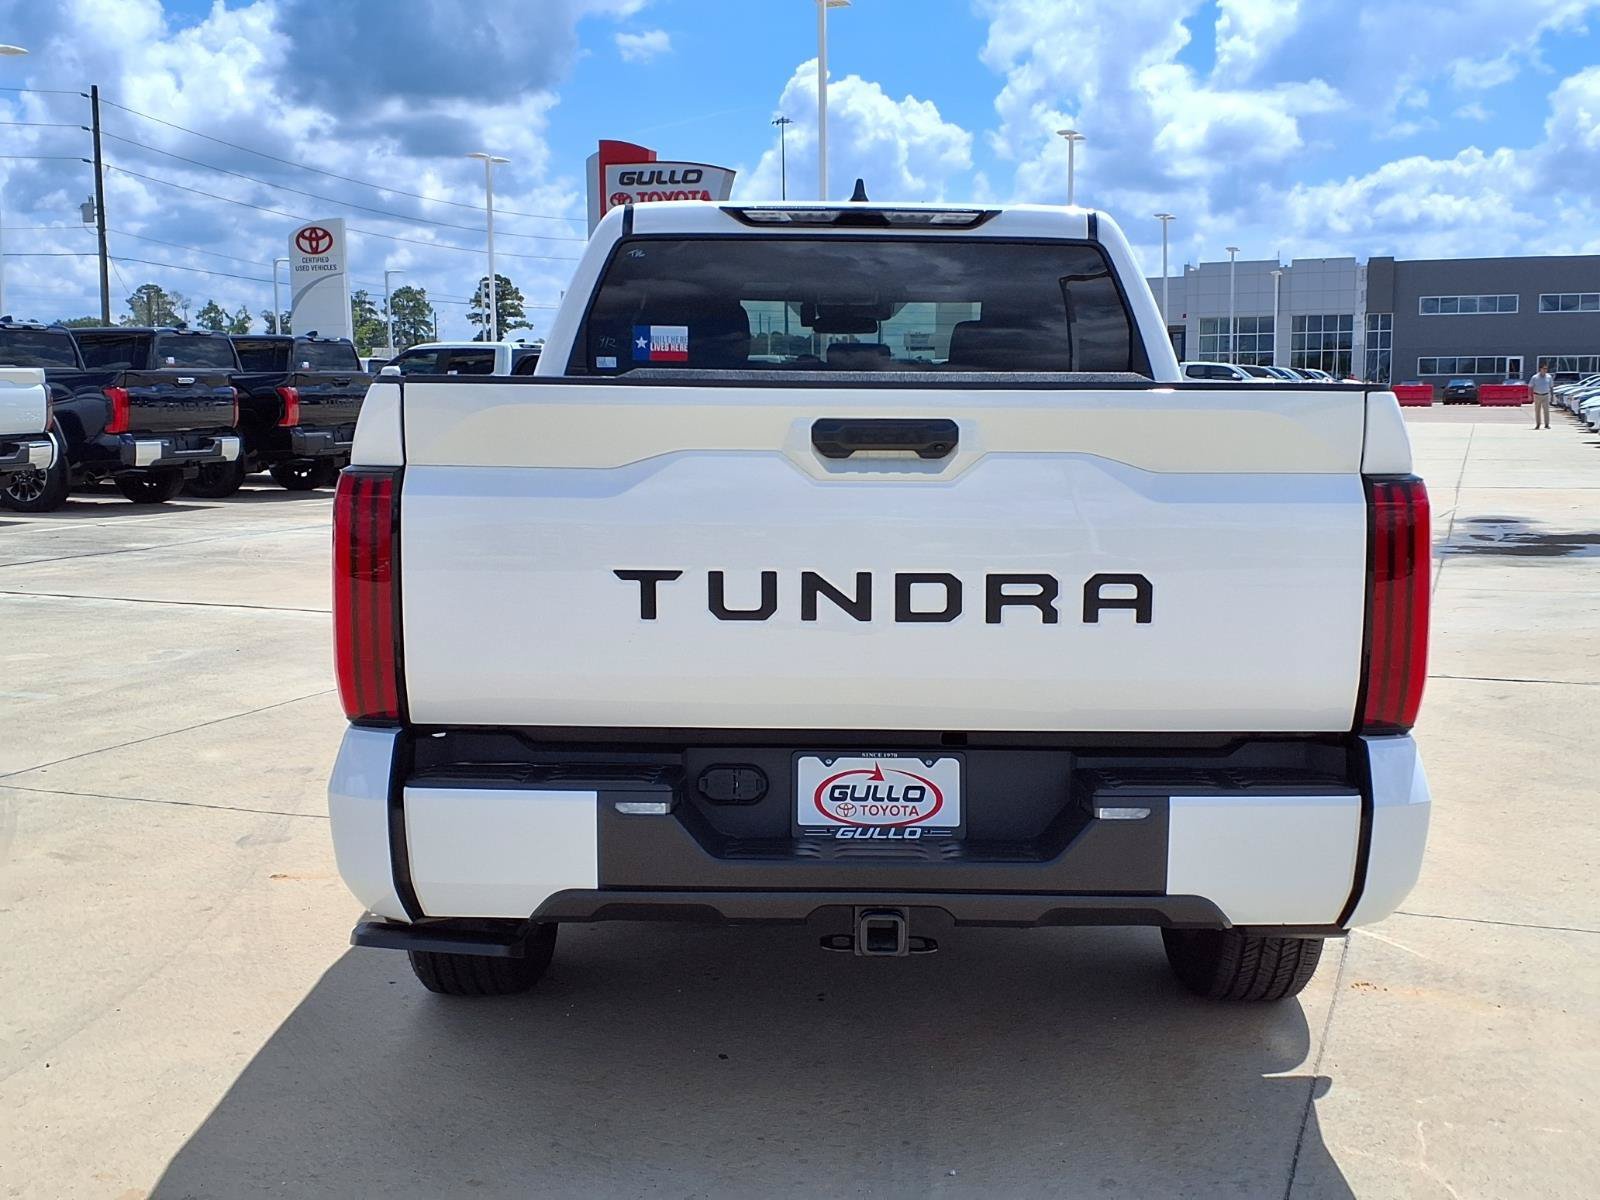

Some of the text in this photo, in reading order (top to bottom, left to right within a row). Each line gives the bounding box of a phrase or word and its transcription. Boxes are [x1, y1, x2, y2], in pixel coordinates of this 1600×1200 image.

[618, 169, 703, 185] GULLO
[636, 190, 713, 202] TOYOTA
[650, 343, 688, 352] LIVED HERE
[612, 569, 1153, 624] TUNDRA
[828, 785, 926, 802] GULLO
[860, 805, 919, 816] TOYOTA
[835, 827, 922, 839] GULLO
